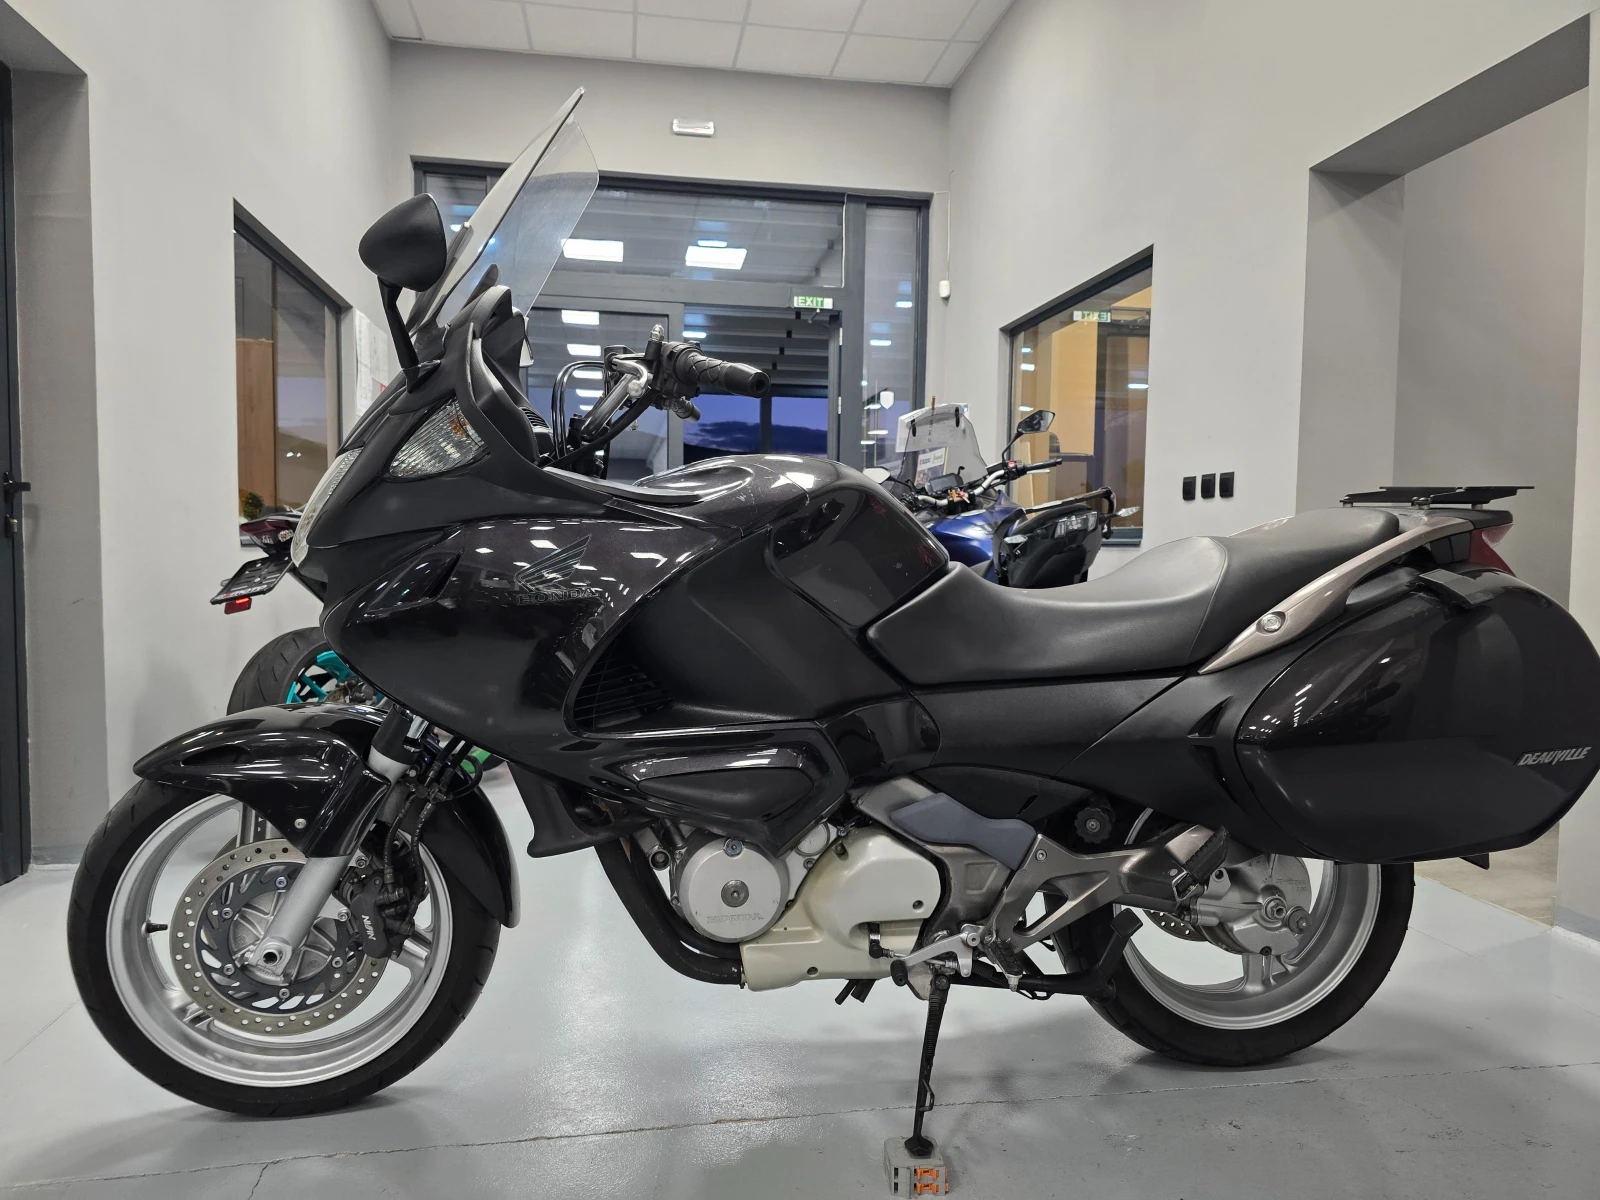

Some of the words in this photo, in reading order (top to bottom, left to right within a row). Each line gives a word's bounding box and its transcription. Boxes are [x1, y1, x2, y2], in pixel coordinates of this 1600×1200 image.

[798, 296, 824, 307] EXIT
[516, 586, 600, 605] HONDA
[1517, 746, 1592, 765] DEAUVILLE
[706, 912, 764, 924] HONDA
